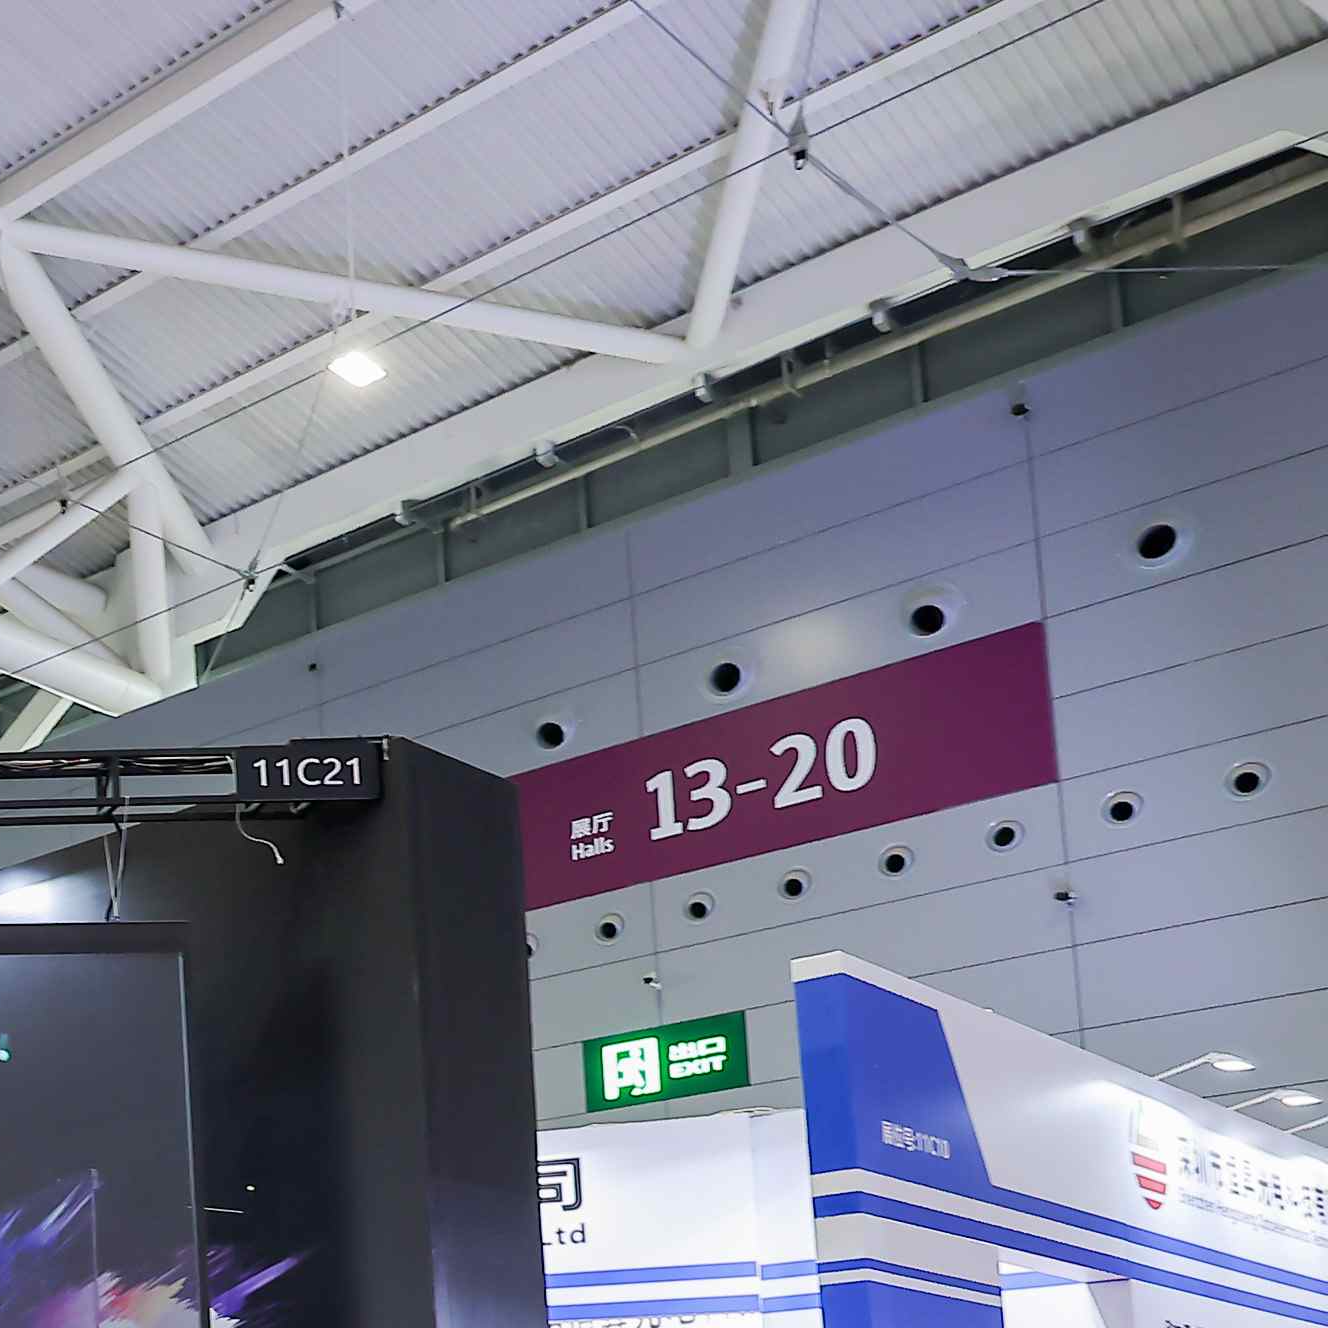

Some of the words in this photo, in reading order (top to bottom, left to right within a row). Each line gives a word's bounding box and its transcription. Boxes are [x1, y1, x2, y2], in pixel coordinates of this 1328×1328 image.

[253, 757, 361, 786] 11C21
[646, 717, 877, 841] 13-20
[571, 811, 614, 840] 展厅
[571, 837, 614, 861] Halls
[668, 1036, 726, 1061] 出口
[668, 1055, 727, 1079] EXIT
[543, 1223, 586, 1245] td
